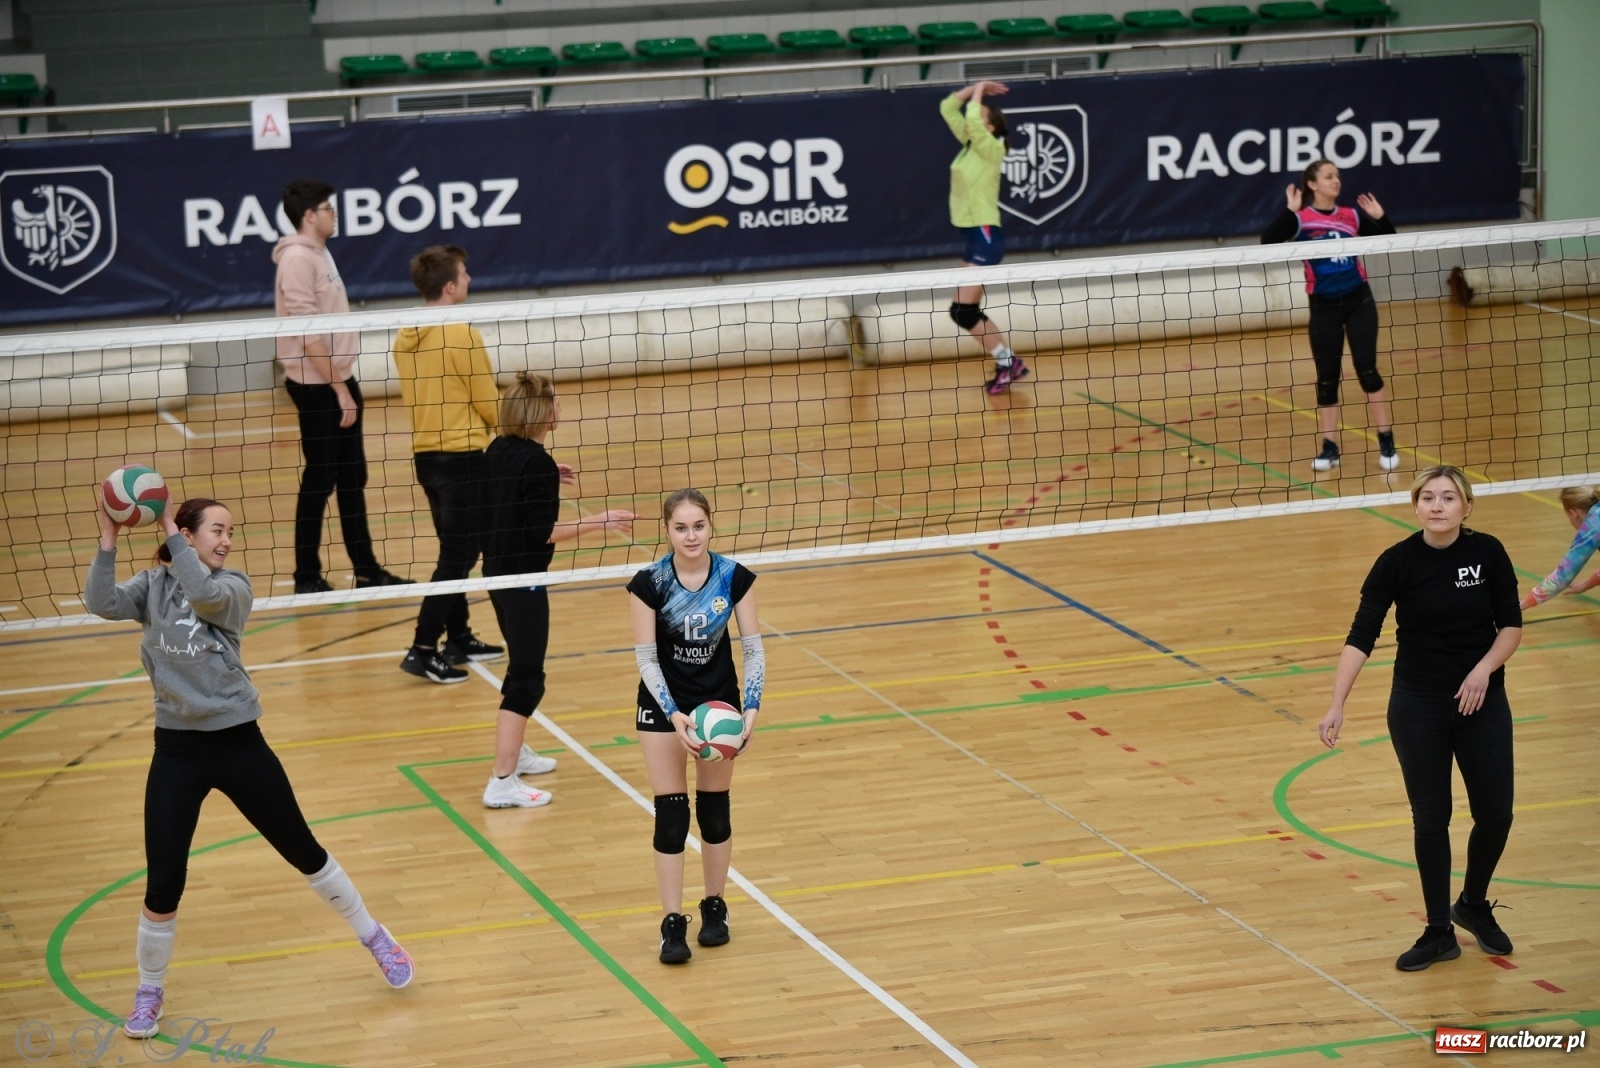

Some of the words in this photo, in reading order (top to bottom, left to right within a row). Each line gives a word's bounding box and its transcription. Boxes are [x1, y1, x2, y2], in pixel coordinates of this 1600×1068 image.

[260, 114, 281, 138] A
[1147, 107, 1441, 181] RACIBÓRZ
[739, 202, 849, 229] RACIBÓRZ
[1457, 564, 1482, 580] PV
[684, 613, 709, 641] 12
